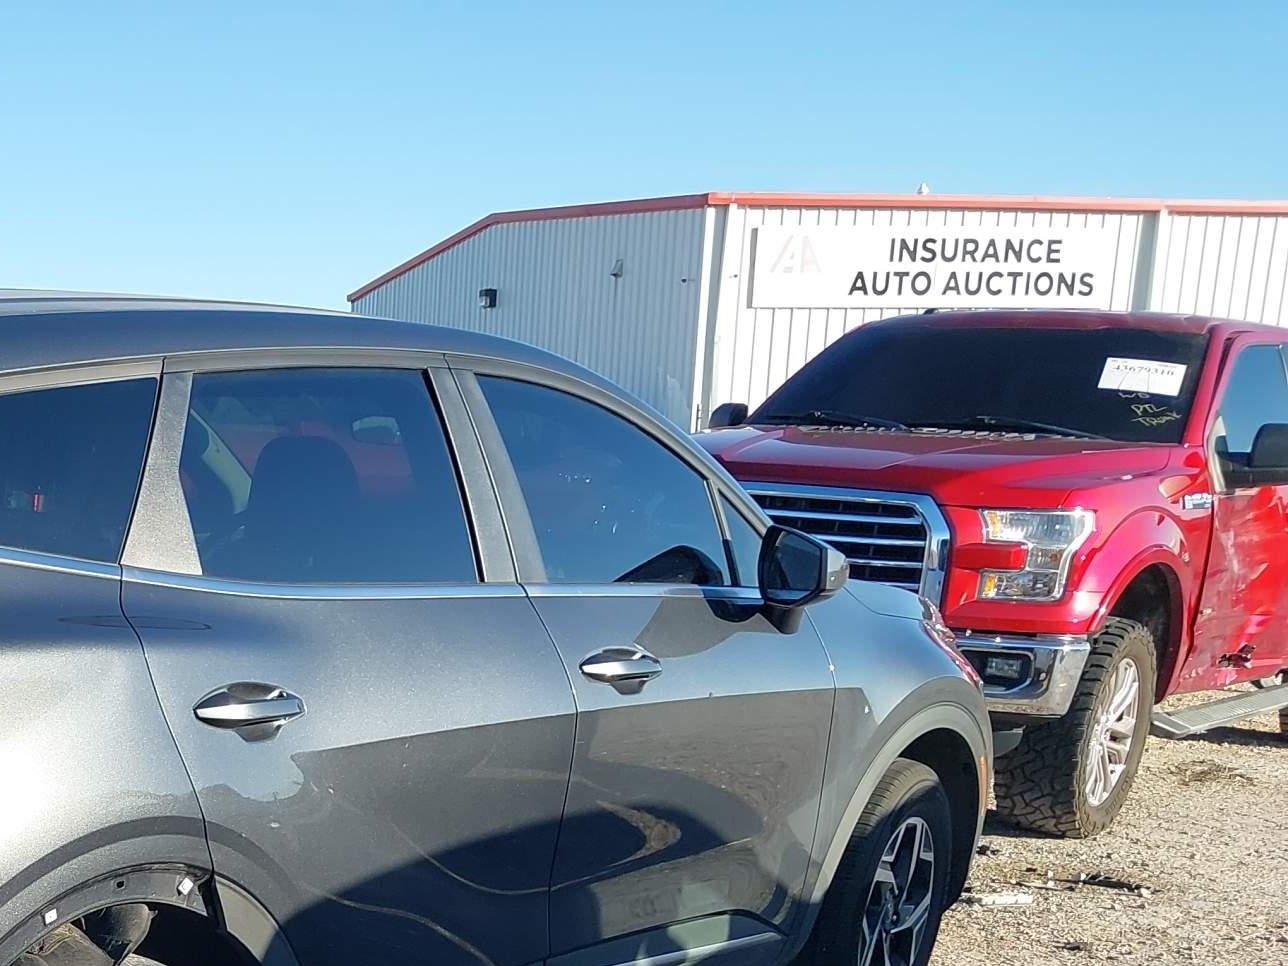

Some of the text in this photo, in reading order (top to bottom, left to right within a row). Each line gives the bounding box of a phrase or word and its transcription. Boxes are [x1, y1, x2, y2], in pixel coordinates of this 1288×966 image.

[889, 238, 1062, 263] INSURANCE
[848, 271, 1094, 297] AUTO AUCTIONS
